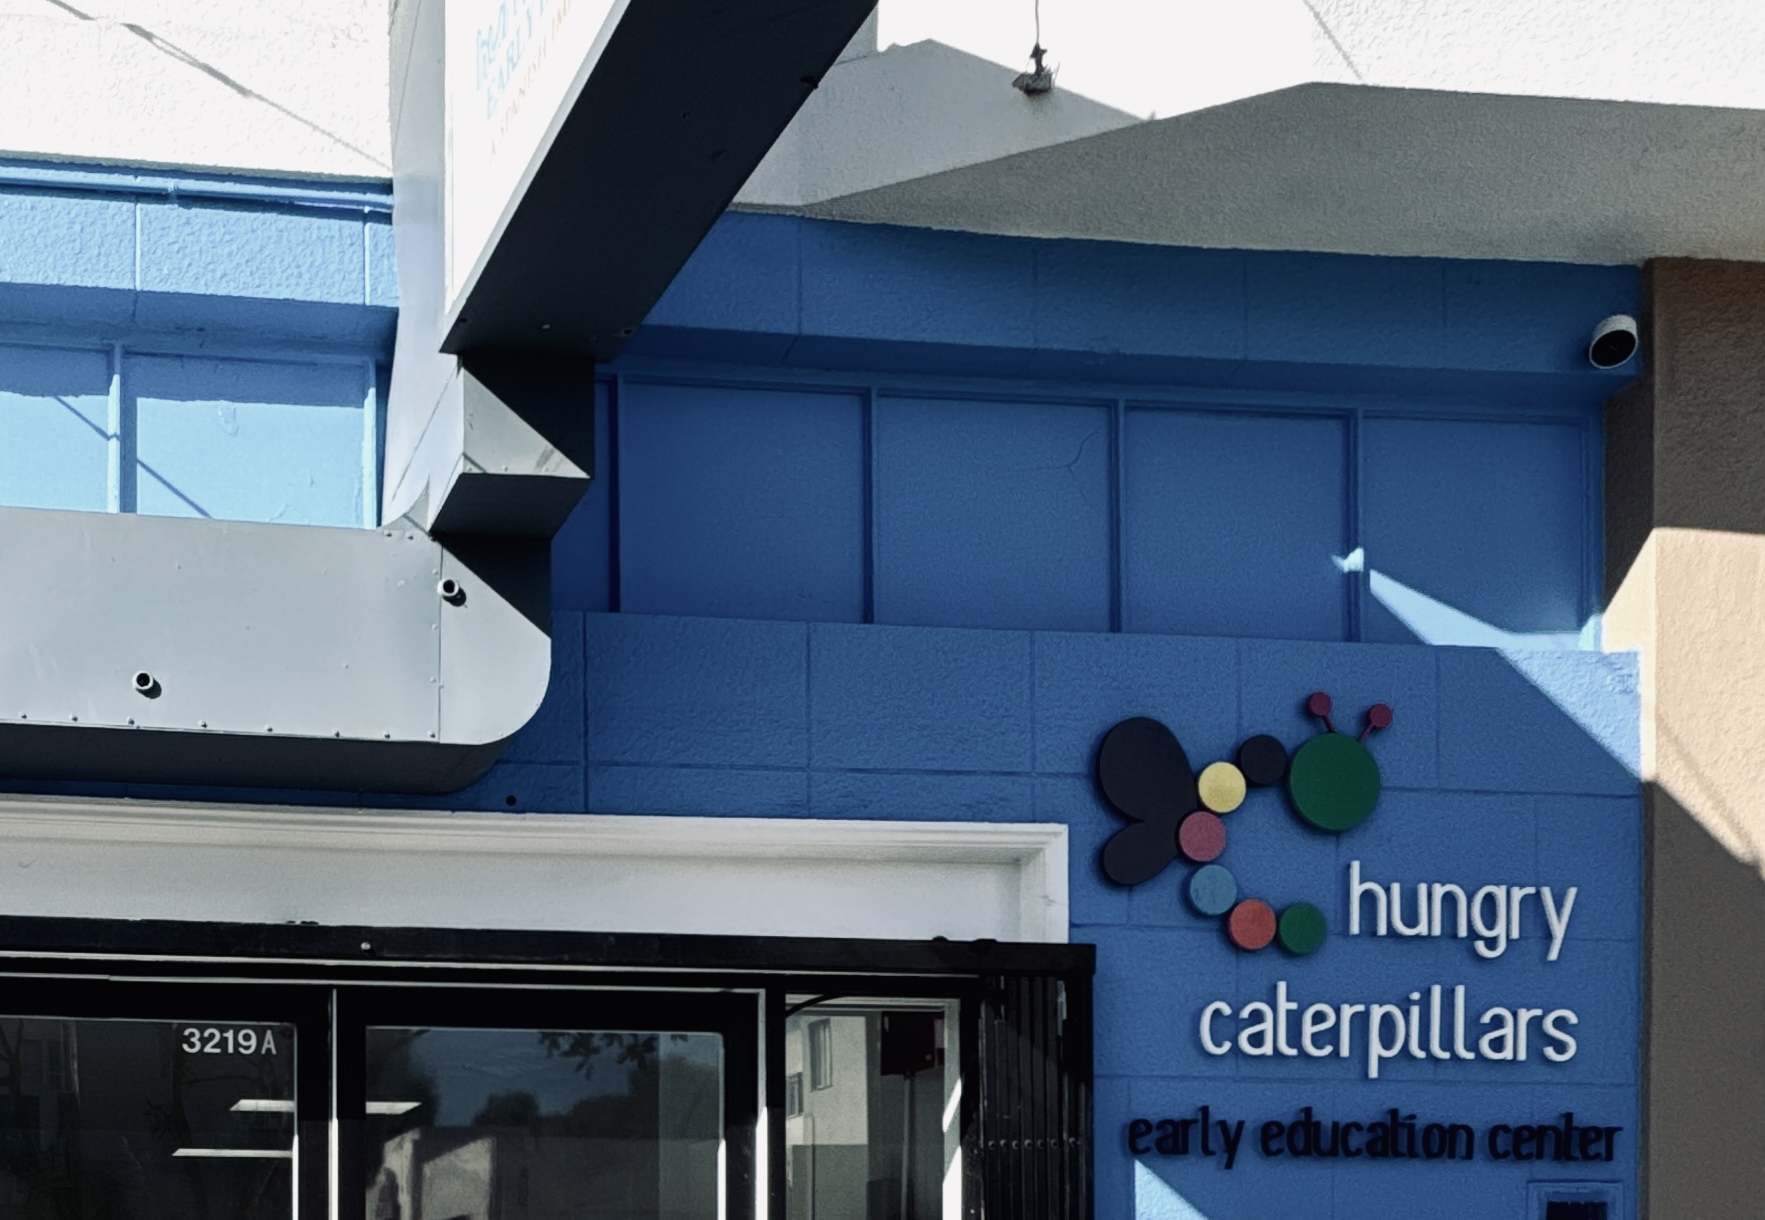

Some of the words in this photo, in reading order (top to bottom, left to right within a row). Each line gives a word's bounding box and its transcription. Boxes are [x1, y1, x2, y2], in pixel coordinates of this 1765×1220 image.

[1348, 860, 1578, 961] hungry
[1199, 981, 1579, 1079] caterpillars
[1126, 1105, 1246, 1170] early
[1260, 1106, 1475, 1160] education
[1487, 1112, 1624, 1162] center
